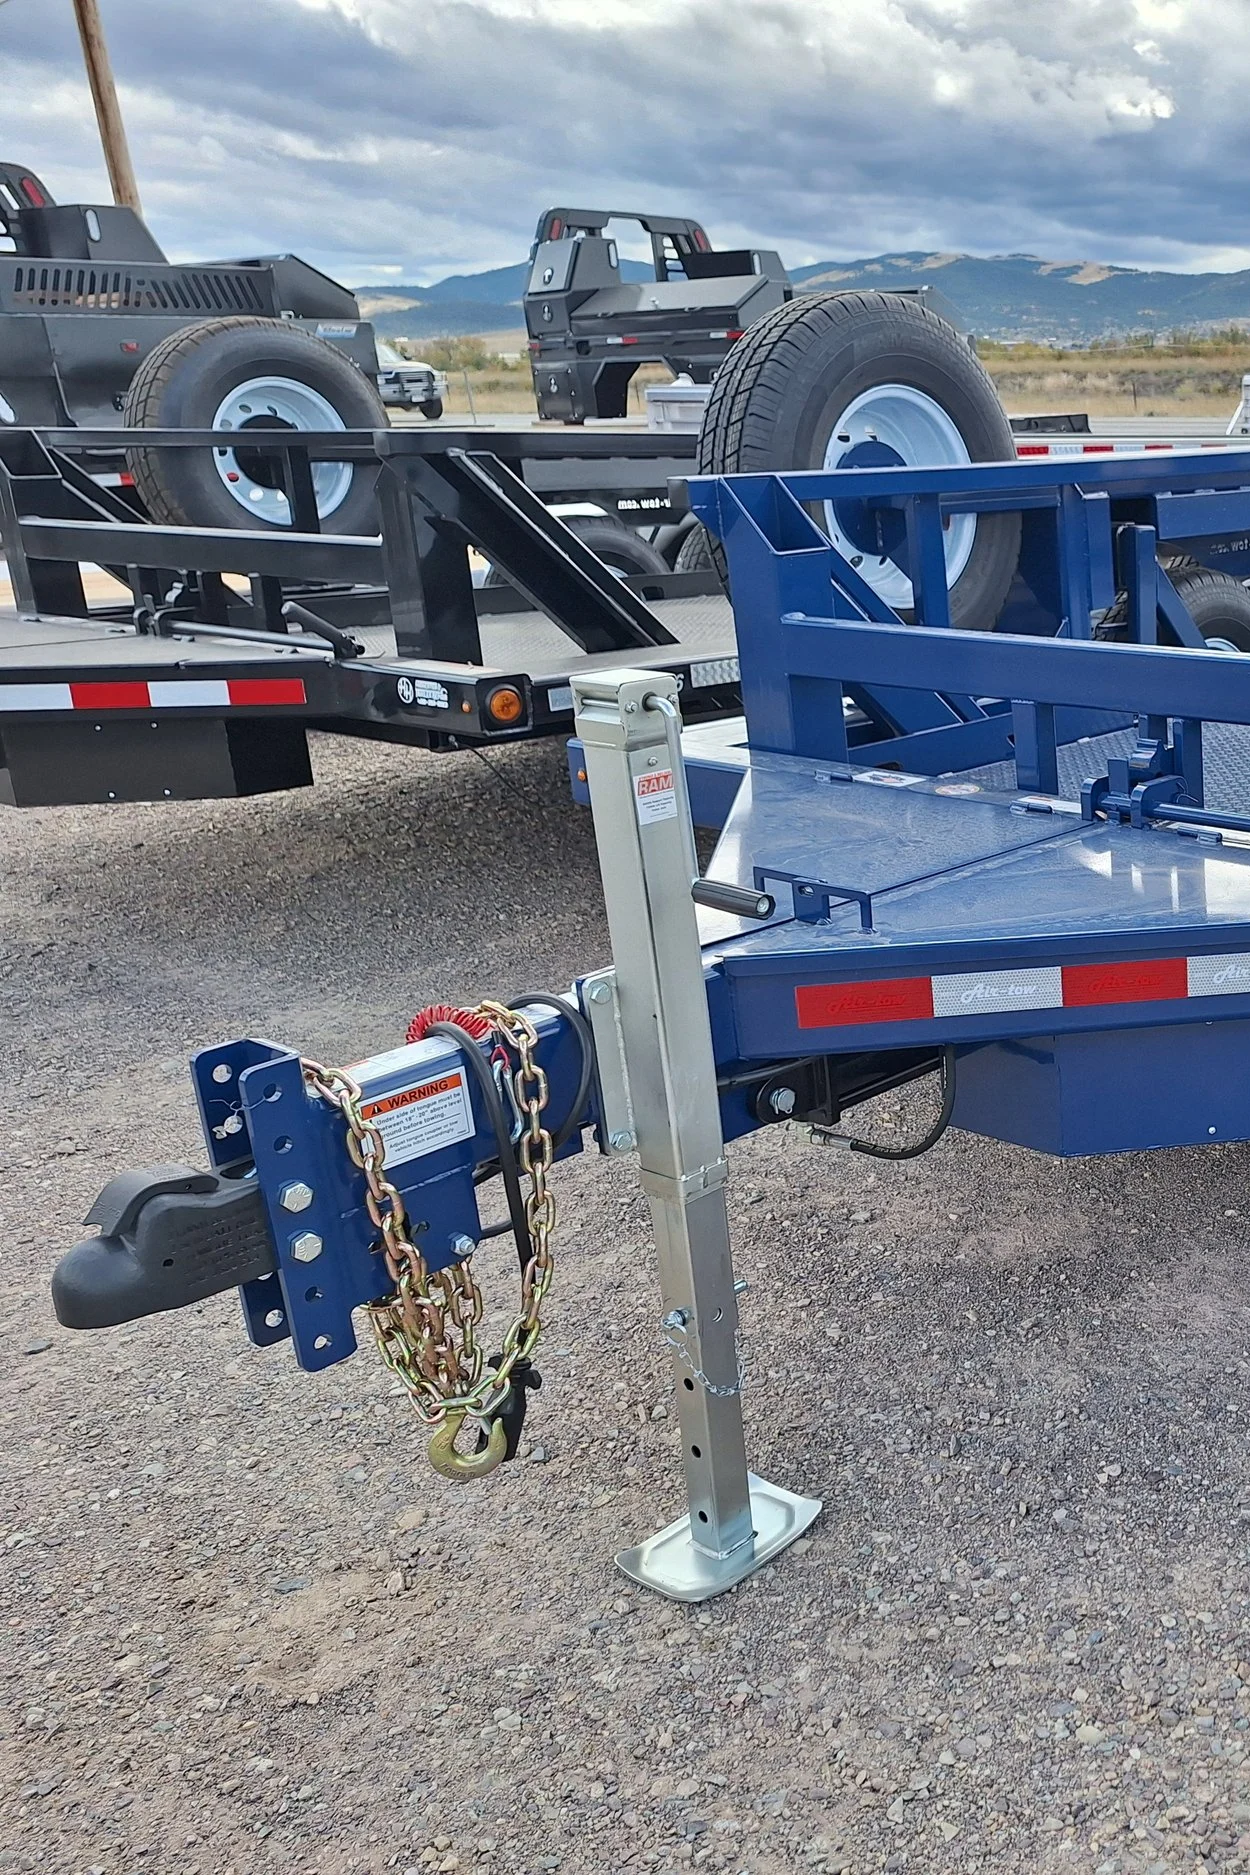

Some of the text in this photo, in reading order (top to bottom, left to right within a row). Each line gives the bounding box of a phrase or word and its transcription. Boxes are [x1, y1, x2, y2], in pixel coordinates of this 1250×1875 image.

[638, 774, 673, 796] RAM
[960, 983, 1036, 1004] Air-tow
[388, 1080, 448, 1108] WARNING
[377, 1116, 395, 1126] Under
[396, 1111, 408, 1119] side
[417, 1101, 437, 1113] tongue
[438, 1095, 453, 1103] must
[429, 1104, 447, 1114] above
[448, 1098, 462, 1107] level
[381, 1128, 403, 1139] round
[403, 1120, 422, 1131] before
